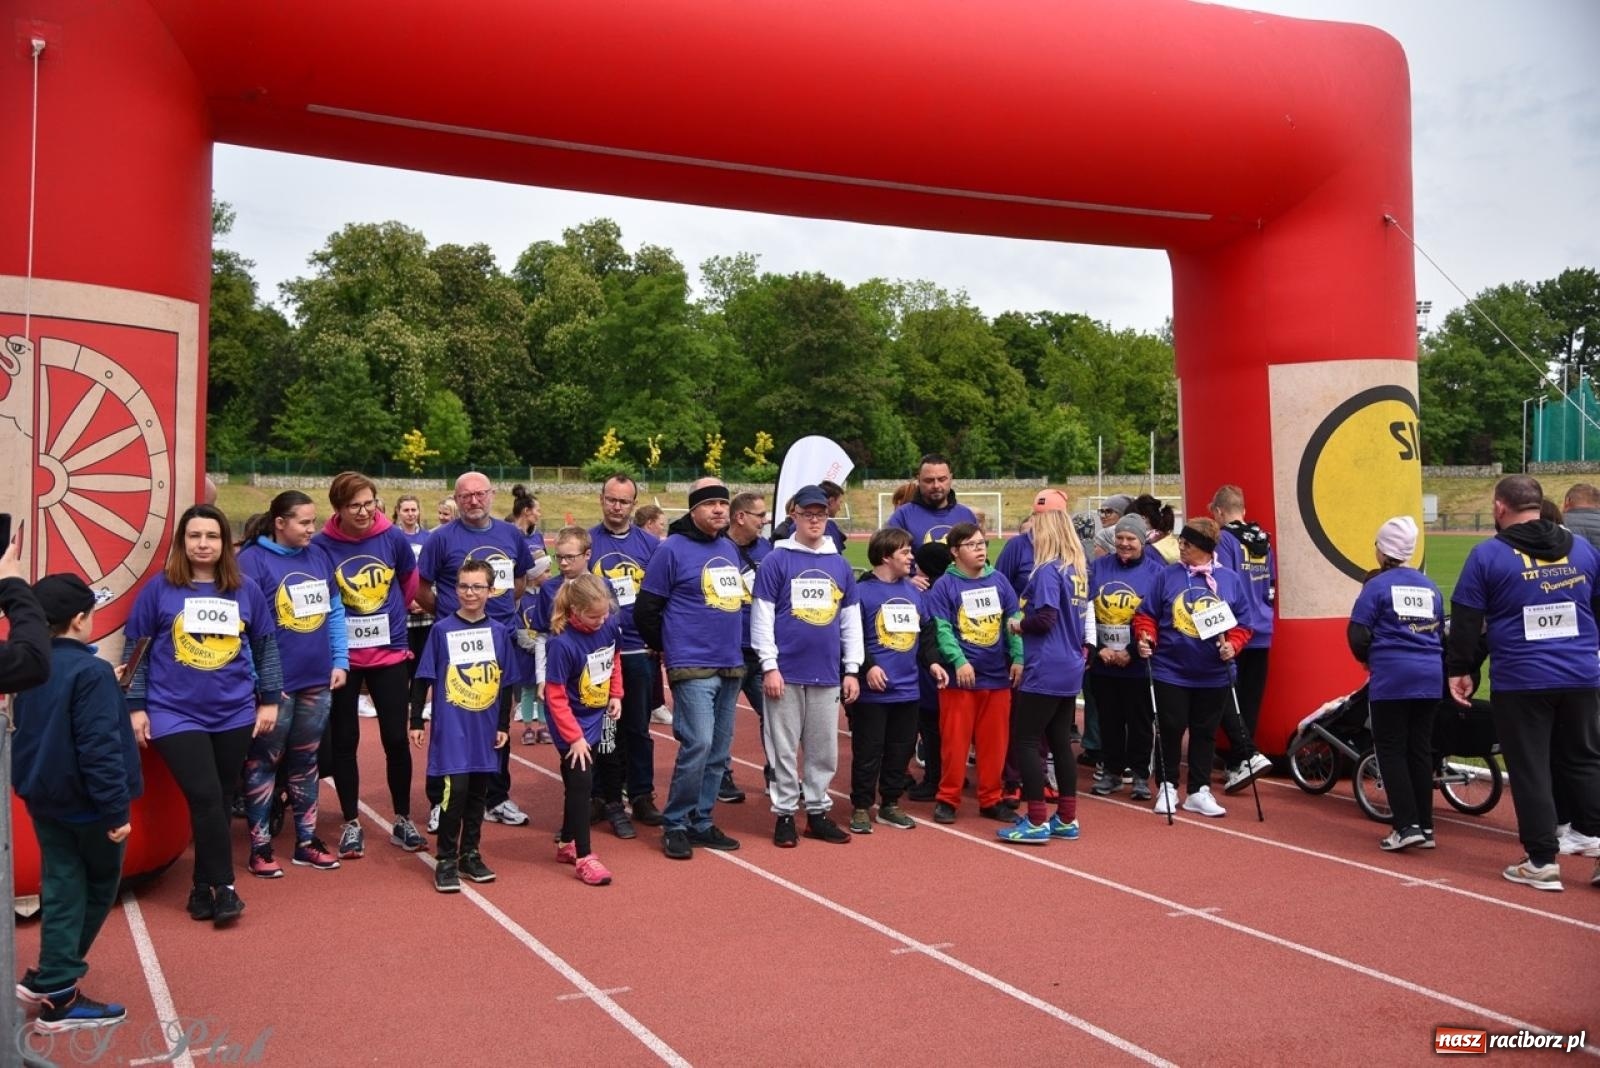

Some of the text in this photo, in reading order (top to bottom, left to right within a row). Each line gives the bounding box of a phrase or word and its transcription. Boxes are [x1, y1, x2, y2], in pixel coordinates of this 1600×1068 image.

[1521, 567, 1577, 580] T2T SYSTEM
[719, 576, 737, 587] 033
[303, 593, 323, 605] 126
[801, 588, 825, 599] 029
[974, 597, 991, 608] 118
[1404, 596, 1424, 607] 013
[197, 609, 228, 622] 006
[892, 613, 910, 624] 154
[1204, 612, 1225, 627] 025
[1538, 614, 1562, 627] 017
[354, 626, 379, 638] 054
[1103, 633, 1120, 642] 041
[460, 640, 484, 653] 018
